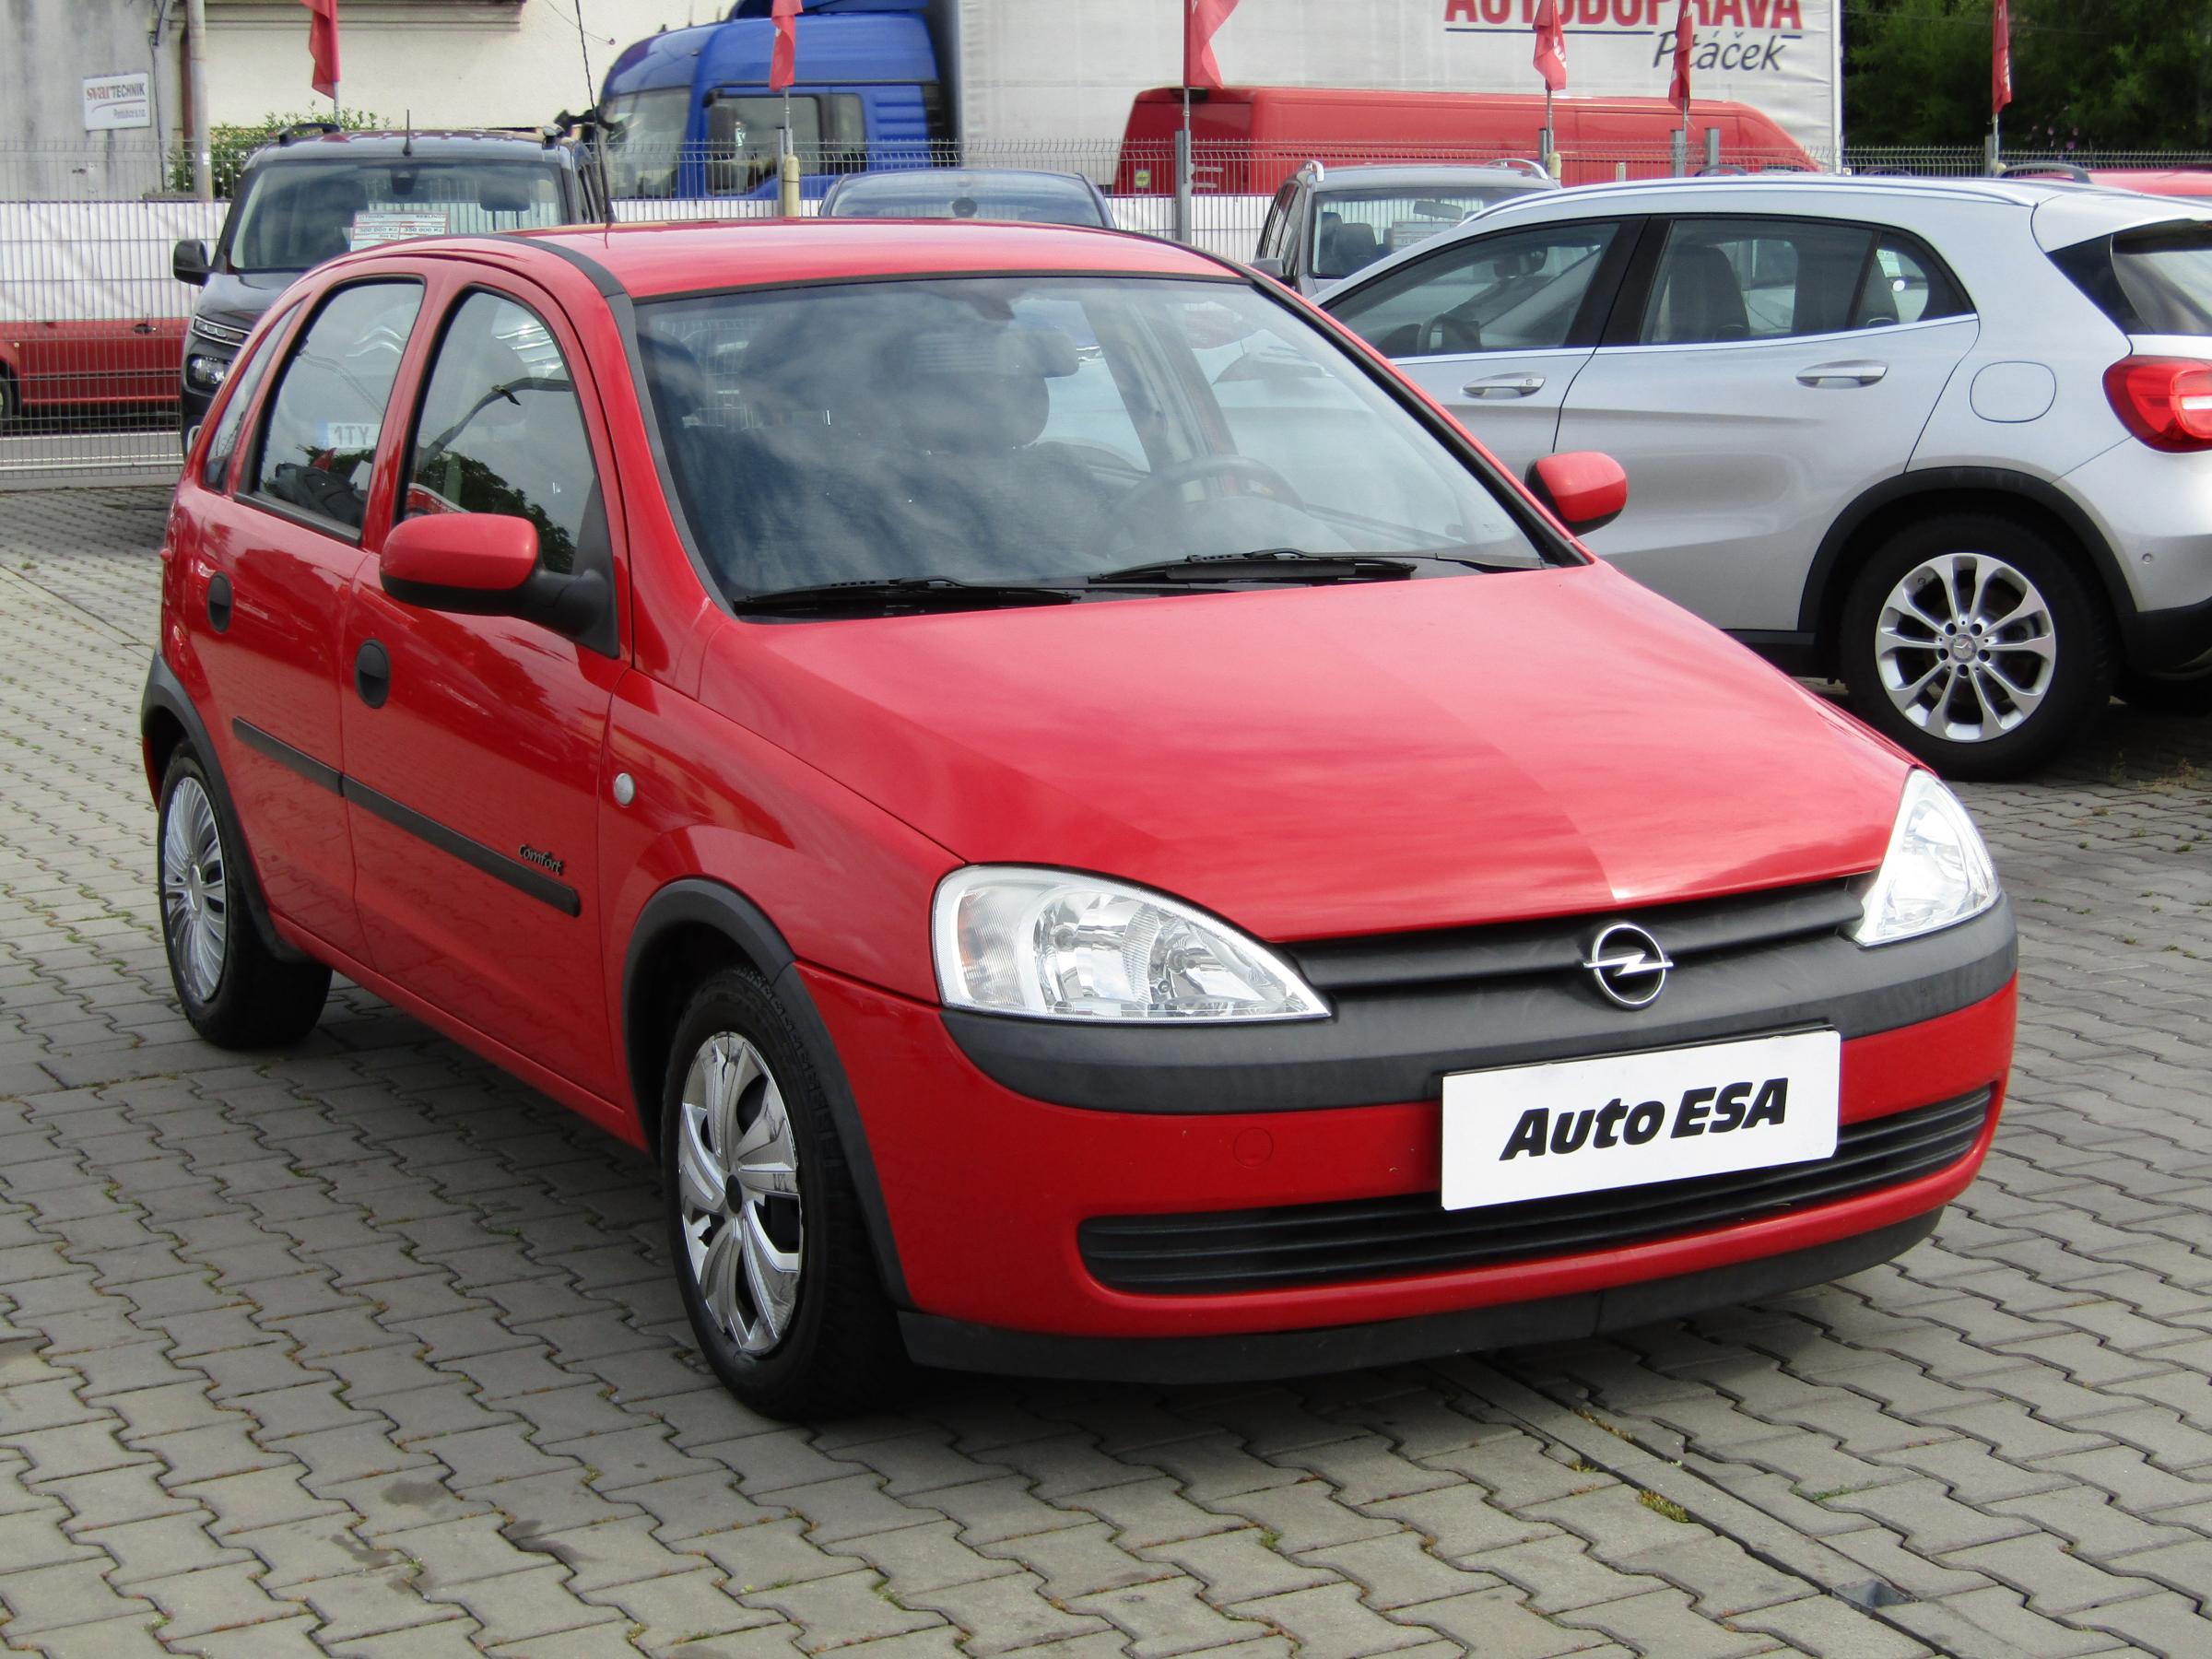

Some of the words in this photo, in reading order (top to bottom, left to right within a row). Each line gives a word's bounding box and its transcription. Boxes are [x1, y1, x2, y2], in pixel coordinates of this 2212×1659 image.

[518, 843, 563, 877] Comfort
[1498, 1098, 1665, 1161] Auto
[1669, 1077, 1789, 1139] ESA
